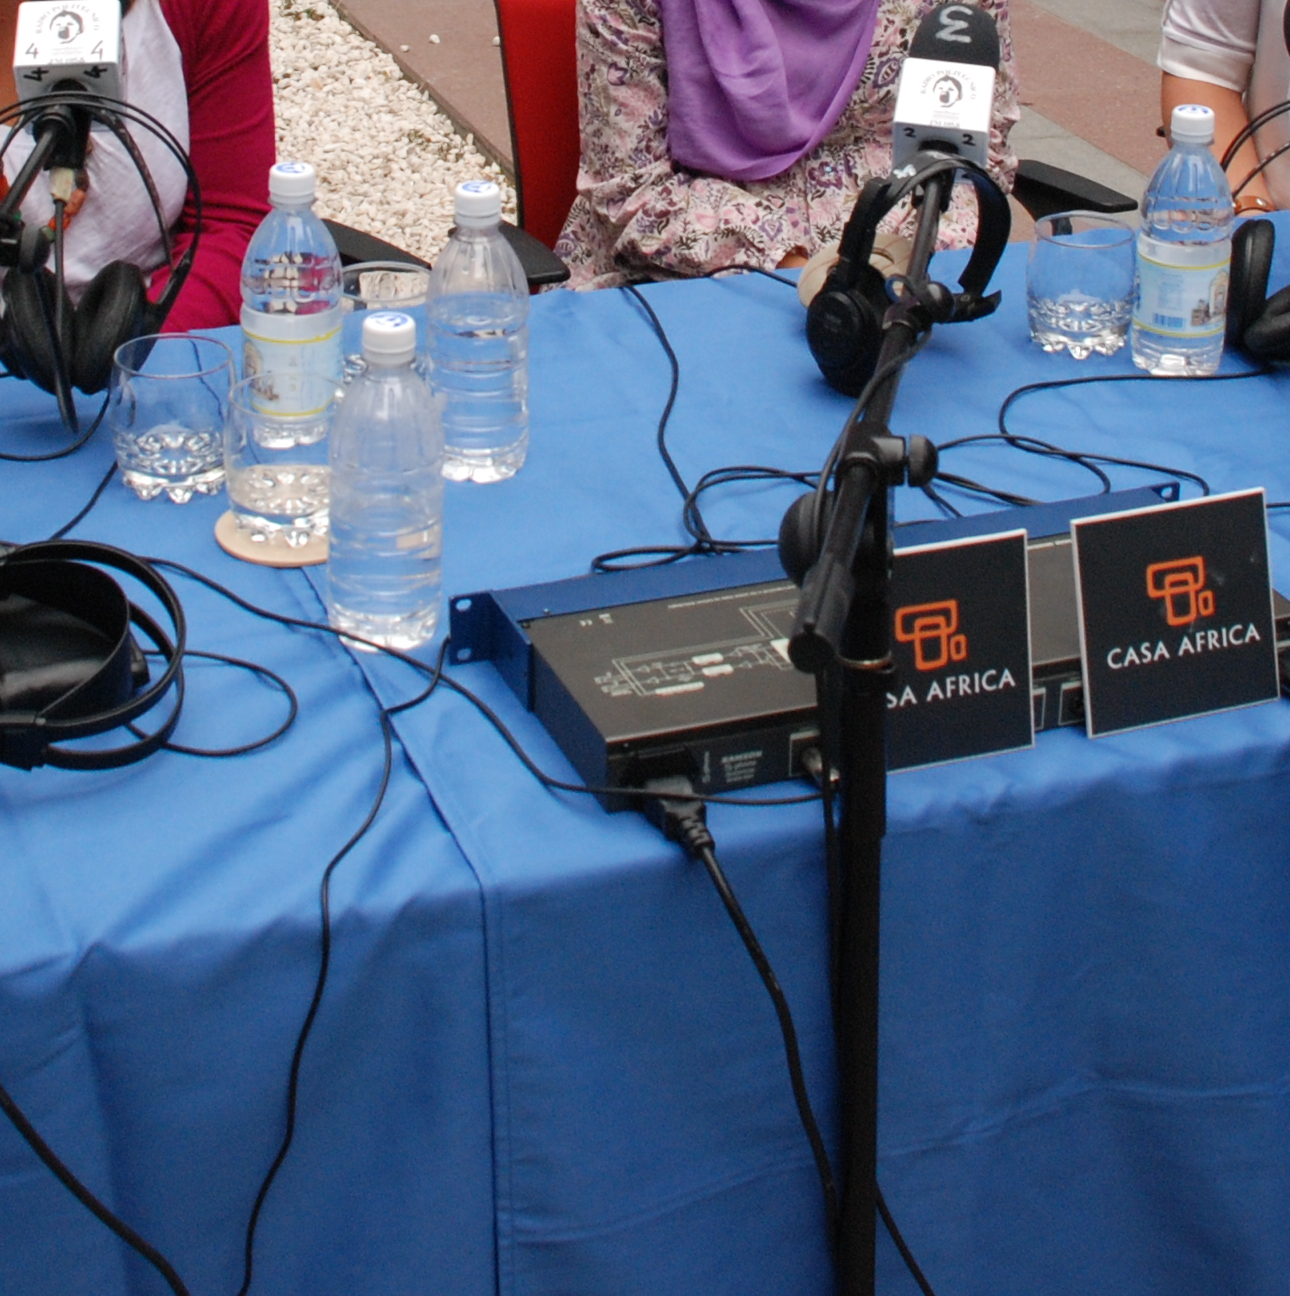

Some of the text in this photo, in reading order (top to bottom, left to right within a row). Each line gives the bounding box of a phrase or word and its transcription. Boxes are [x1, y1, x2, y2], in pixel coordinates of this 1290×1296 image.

[25, 42, 40, 60] 4
[90, 40, 105, 61] 4
[903, 126, 917, 138] 2
[961, 133, 976, 147] 2
[1107, 623, 1261, 670] CASA AFRICA
[886, 668, 1017, 709] SA AFRICA
